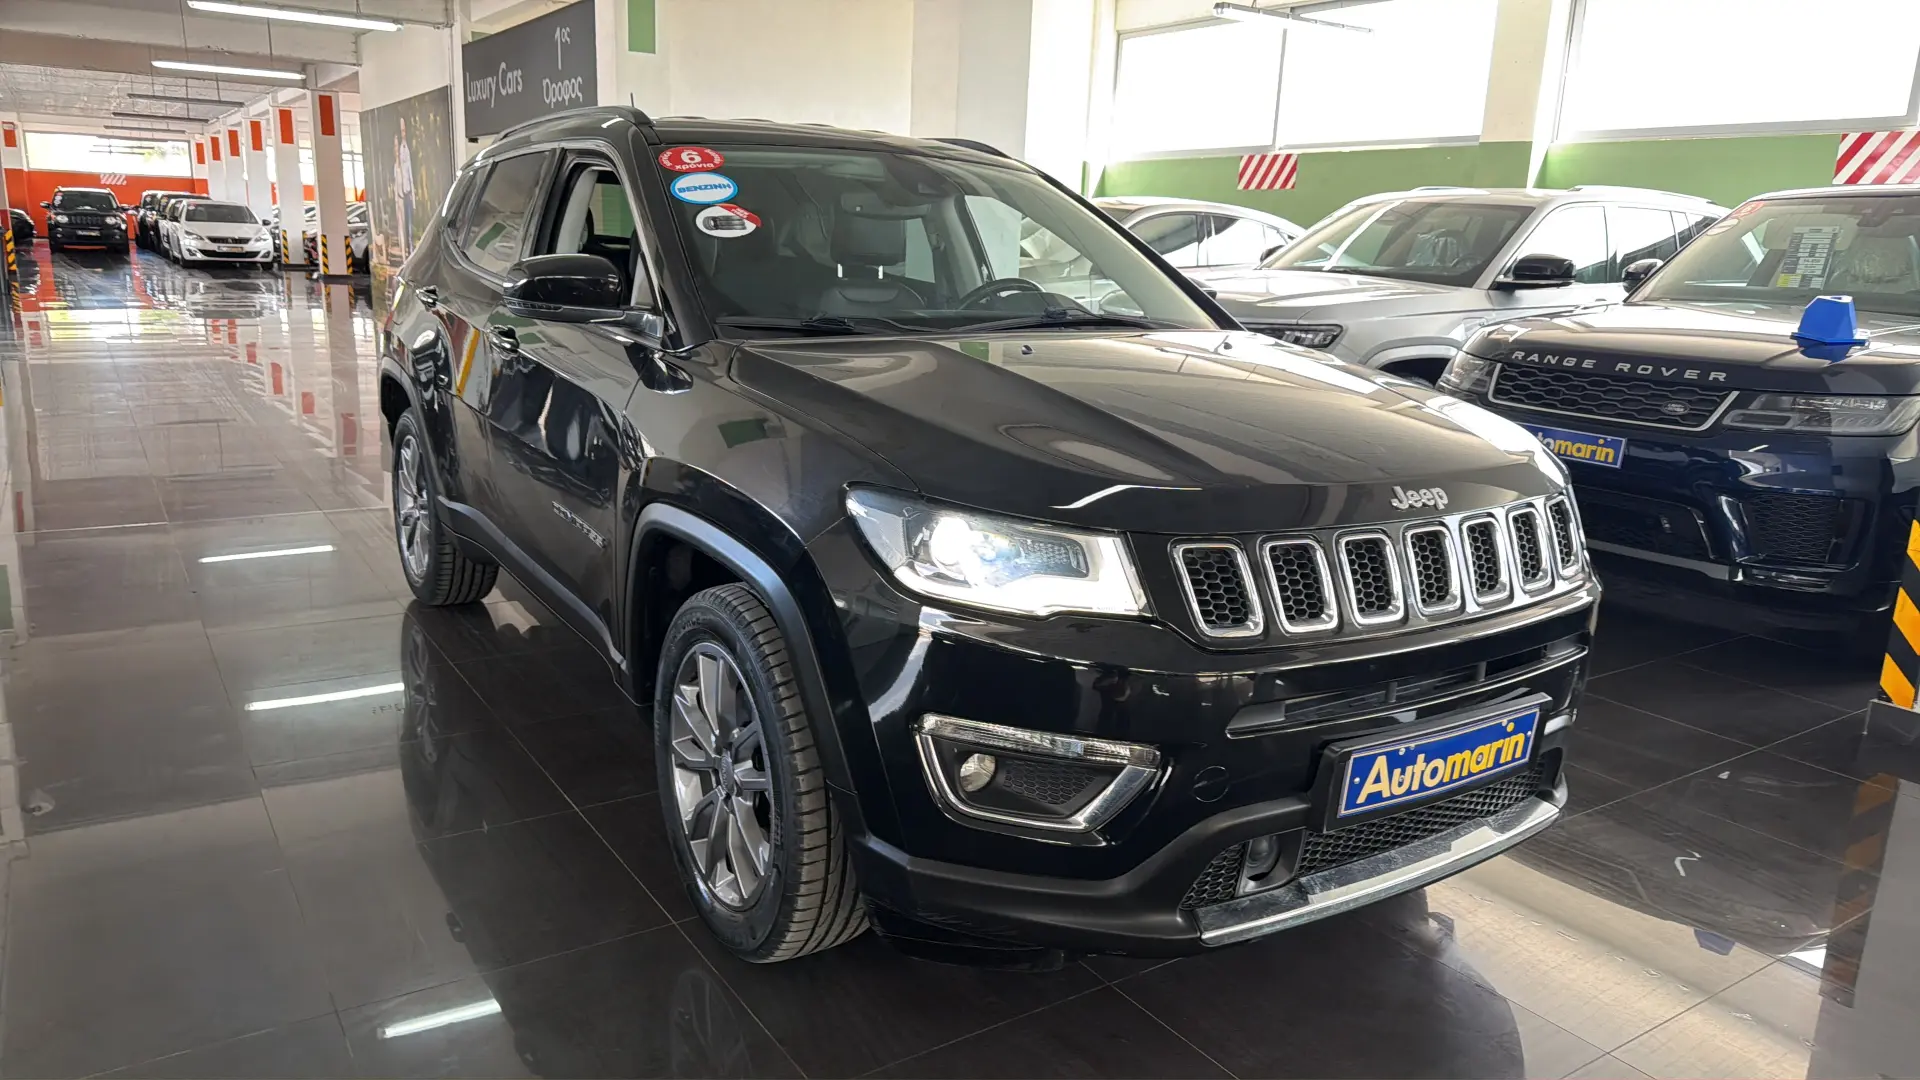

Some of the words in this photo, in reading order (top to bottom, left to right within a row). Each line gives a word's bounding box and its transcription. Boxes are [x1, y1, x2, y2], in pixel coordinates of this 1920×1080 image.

[466, 71, 497, 109] Luxury
[499, 61, 523, 97] Cars
[674, 161, 716, 172] χρόνια
[680, 150, 702, 164] 6
[1511, 350, 1597, 370] RANGE
[1614, 361, 1728, 383] ROVER
[1390, 485, 1449, 510] Jeep
[1355, 721, 1526, 805] Automarin
